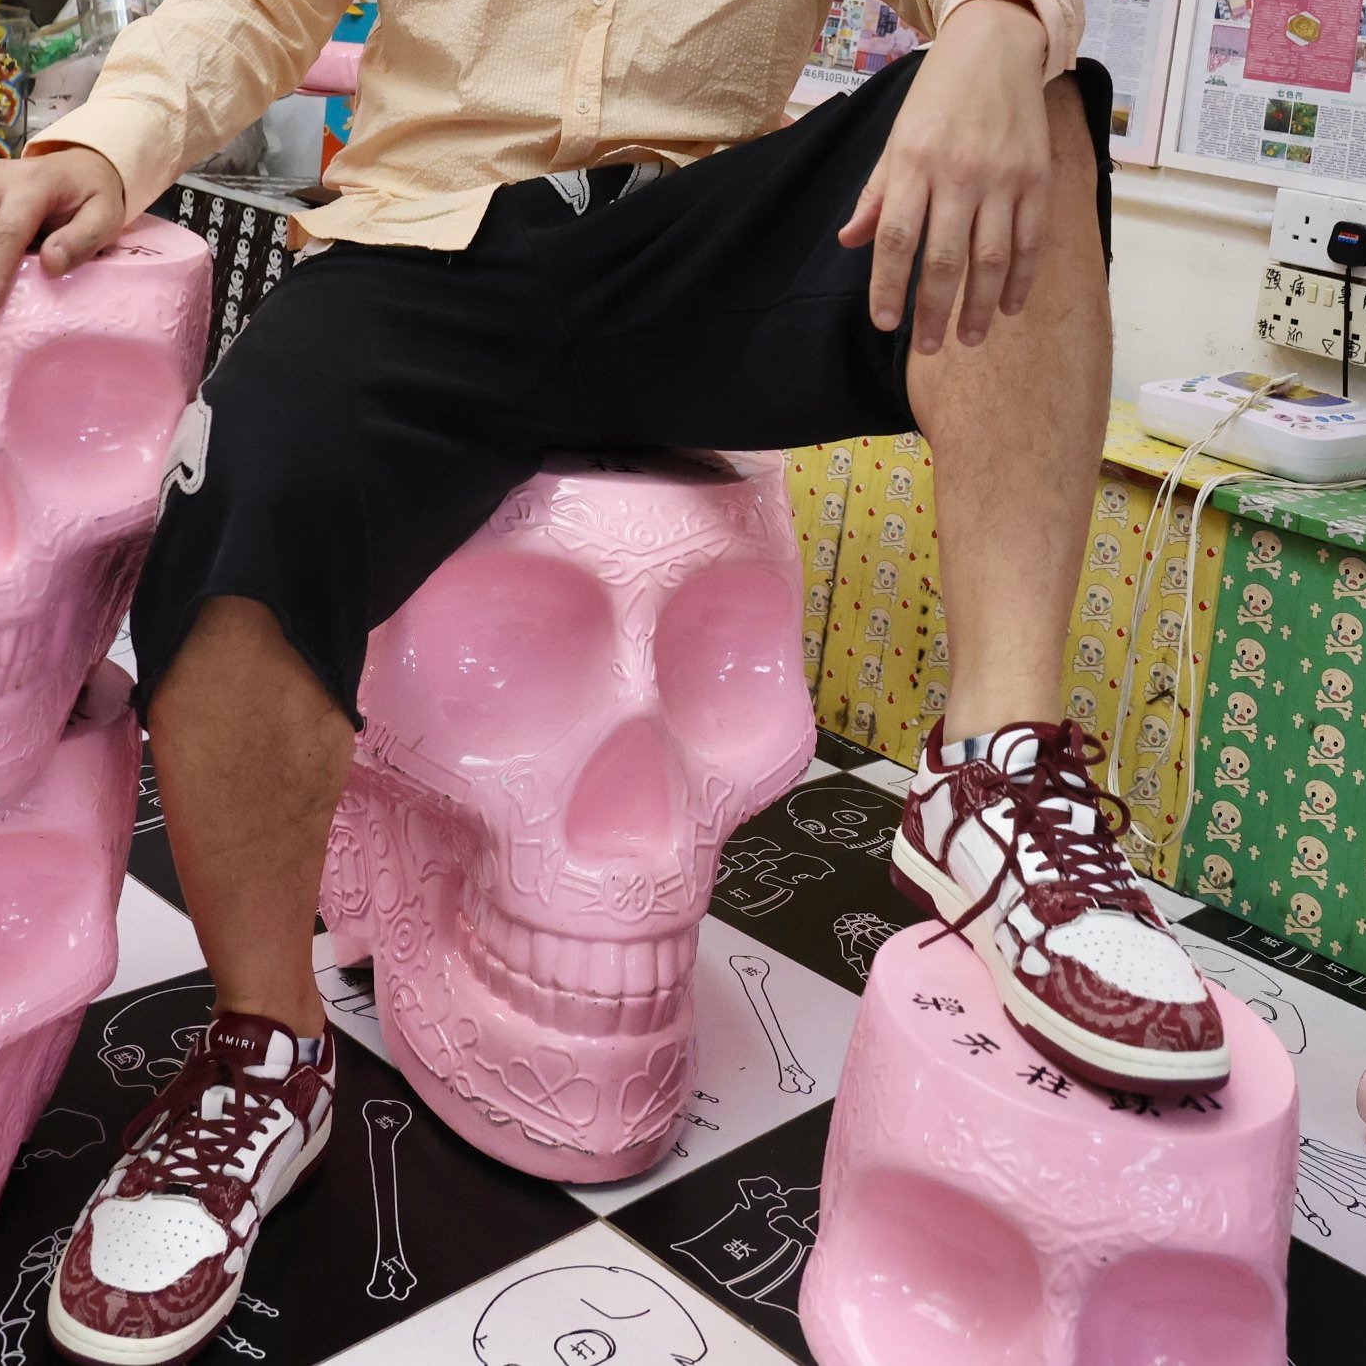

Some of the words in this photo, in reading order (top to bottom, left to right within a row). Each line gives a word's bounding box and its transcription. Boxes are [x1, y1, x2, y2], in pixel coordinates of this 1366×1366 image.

[729, 888, 750, 900] 打
[1261, 936, 1283, 947] 跌
[742, 967, 762, 976] 跌
[1325, 963, 1348, 975] 打
[217, 1033, 256, 1051] AMIRI
[114, 1052, 137, 1064] 跌
[782, 1063, 805, 1079] 打
[375, 1116, 400, 1129] 跌
[723, 1239, 757, 1260] 跌
[382, 1256, 404, 1274] 打
[570, 1339, 595, 1360] 打
